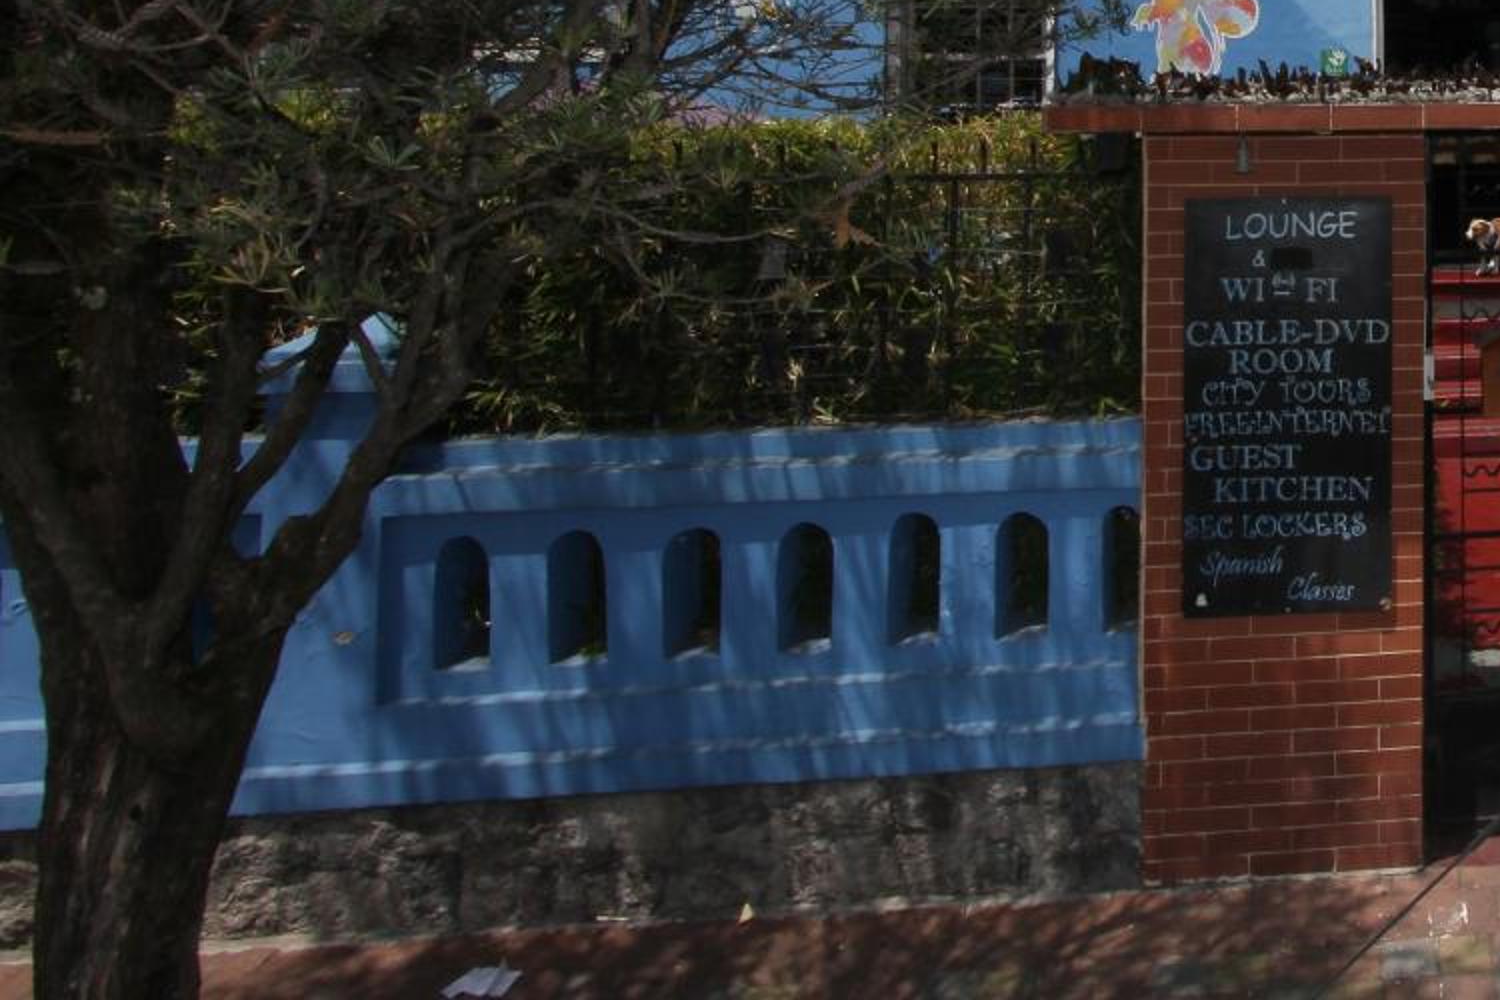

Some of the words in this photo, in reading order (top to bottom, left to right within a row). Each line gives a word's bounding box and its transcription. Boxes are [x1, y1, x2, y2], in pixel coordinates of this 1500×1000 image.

[1225, 210, 1359, 240] LOUNGE
[1229, 347, 1337, 375] ROOM
[1200, 377, 1267, 407] CITY
[1279, 376, 1372, 407] TOURS
[1190, 442, 1304, 472] GUEST
[1214, 475, 1375, 504] KITCHEN
[1183, 513, 1234, 538] SEC
[1242, 510, 1369, 541] LOCKERS
[1199, 543, 1284, 588] Spanish
[1286, 571, 1357, 602] Classes
